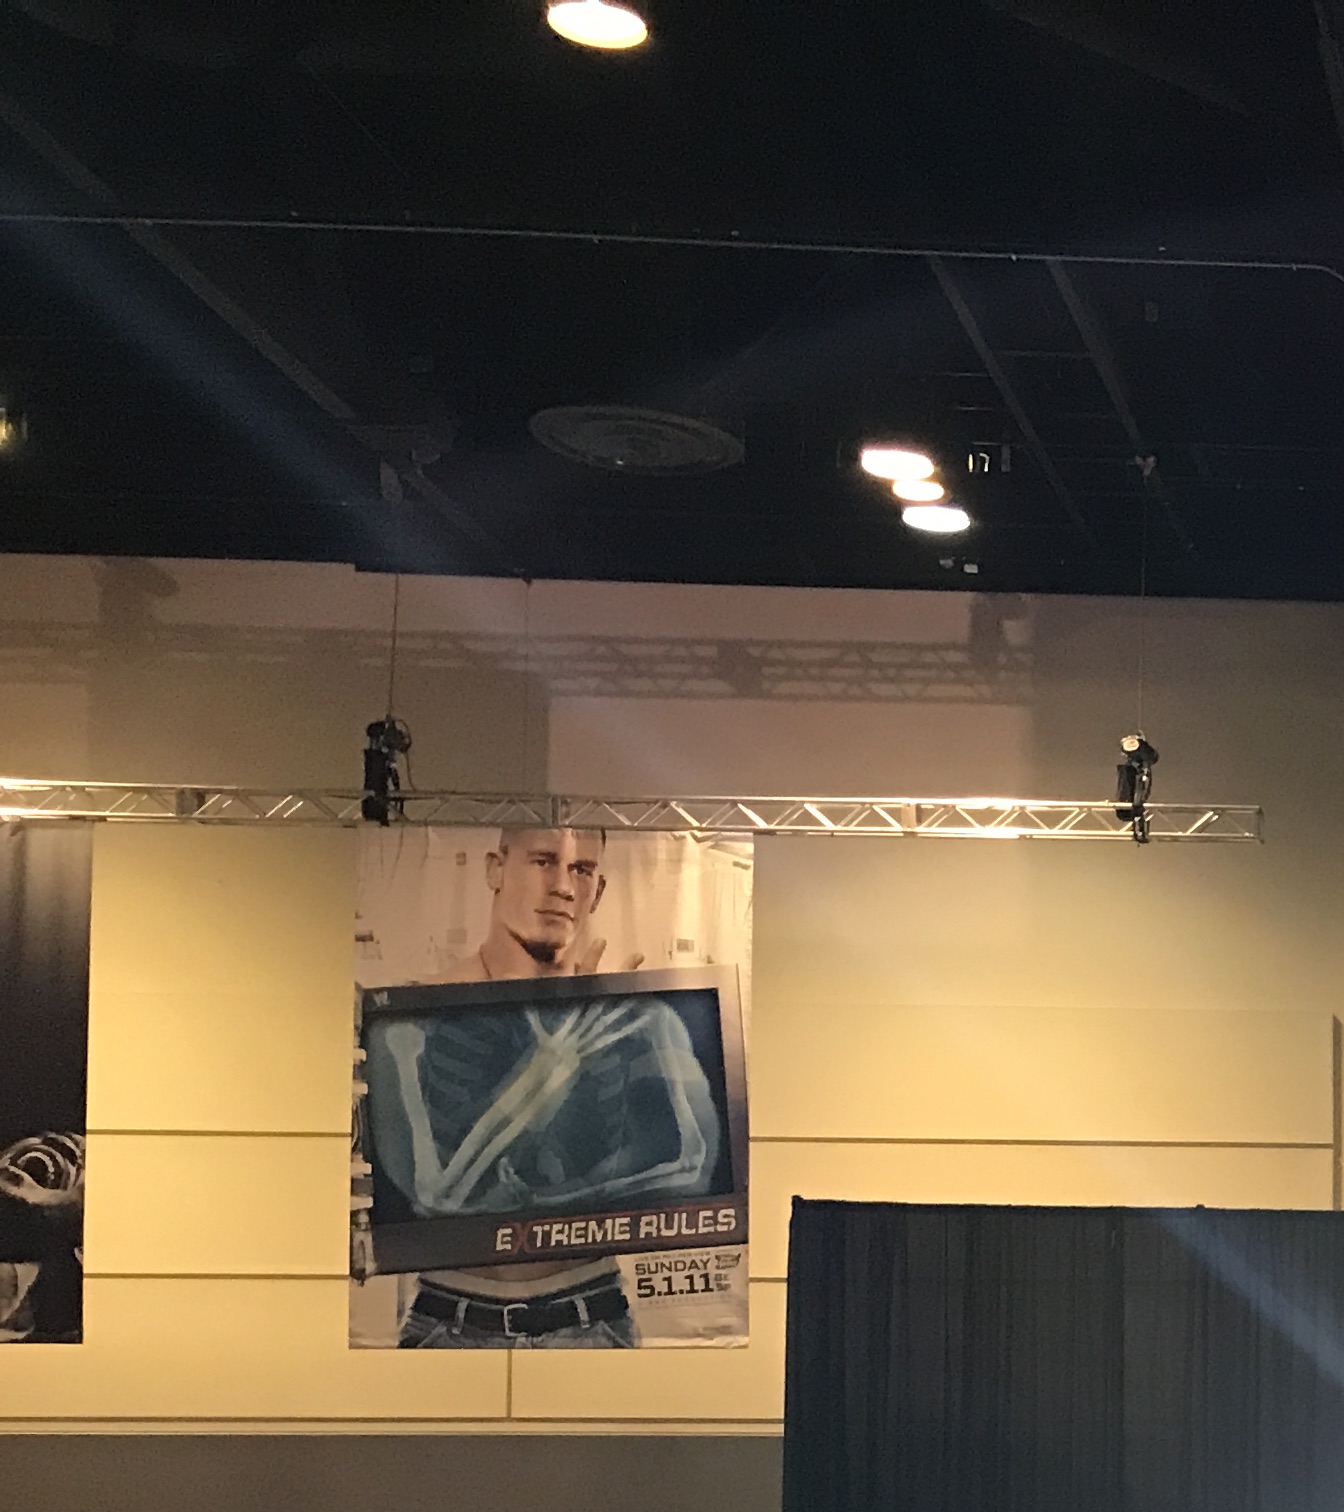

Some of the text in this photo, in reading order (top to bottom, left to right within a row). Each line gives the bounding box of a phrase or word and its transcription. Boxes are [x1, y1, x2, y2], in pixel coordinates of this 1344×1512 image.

[639, 1208, 736, 1239] RULES
[635, 1258, 711, 1276] SUNDAY
[637, 1272, 714, 1299] 5.1.11
